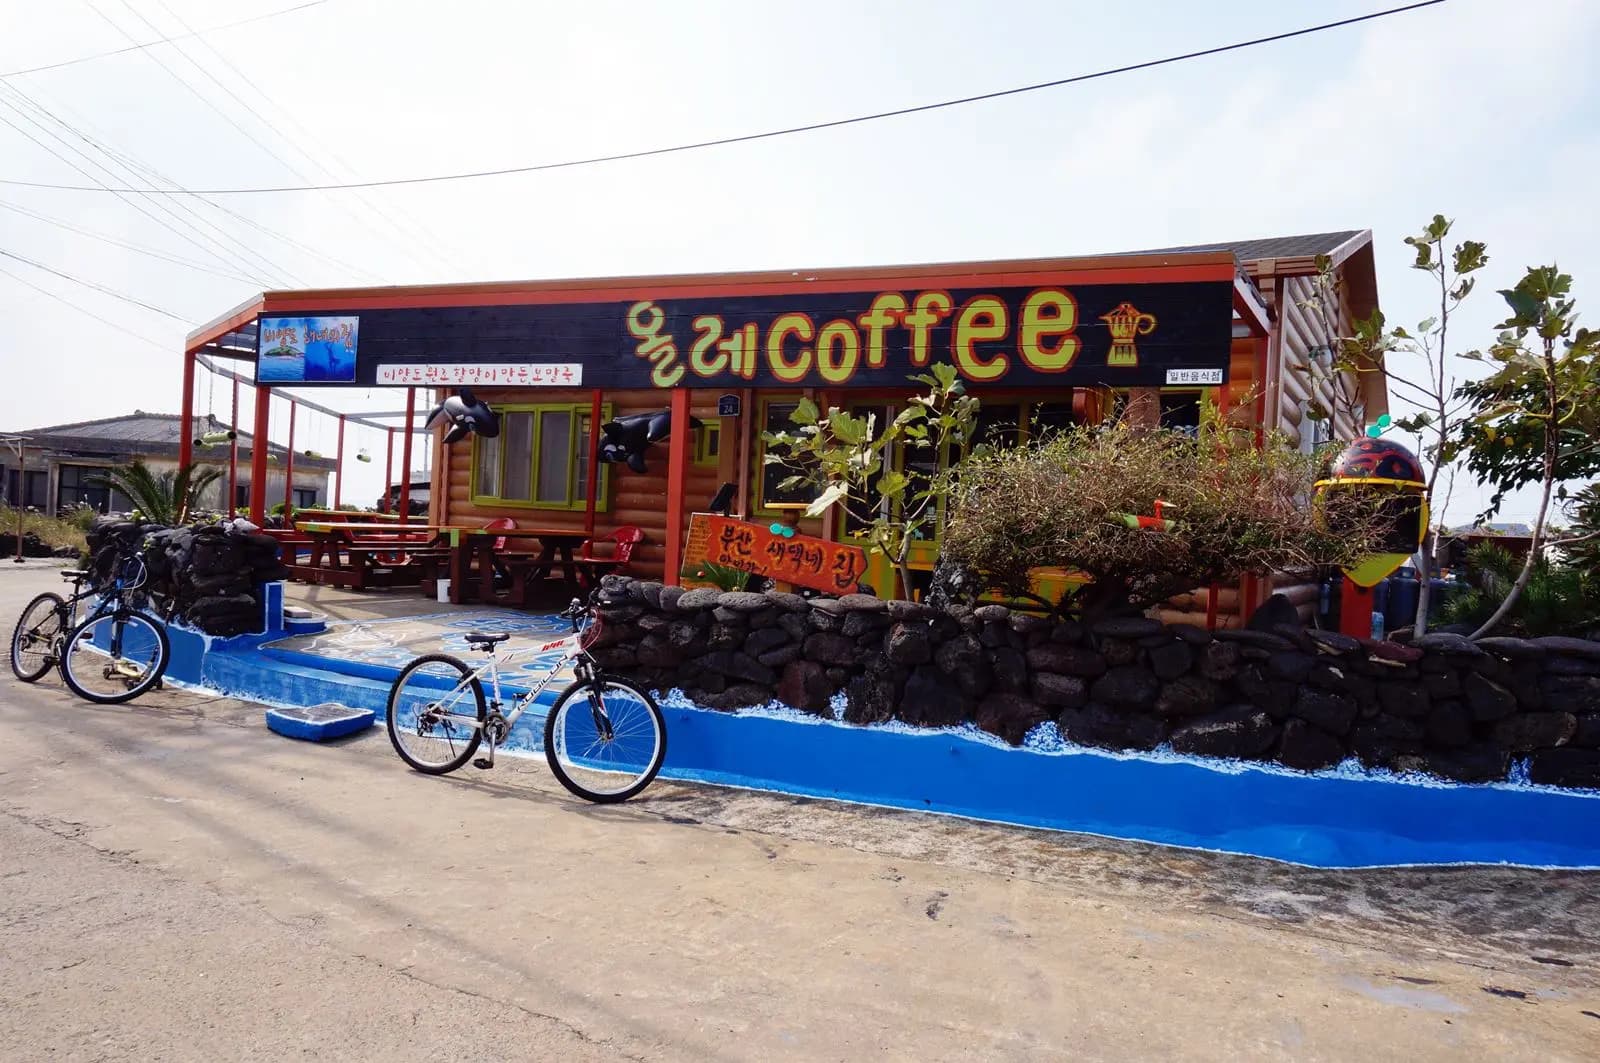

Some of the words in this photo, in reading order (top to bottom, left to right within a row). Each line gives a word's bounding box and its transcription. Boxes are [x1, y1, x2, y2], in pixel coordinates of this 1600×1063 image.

[627, 299, 758, 388] 올레
[1170, 371, 1219, 382] 일반음식점
[719, 524, 752, 556] 부산
[832, 551, 857, 587] 집
